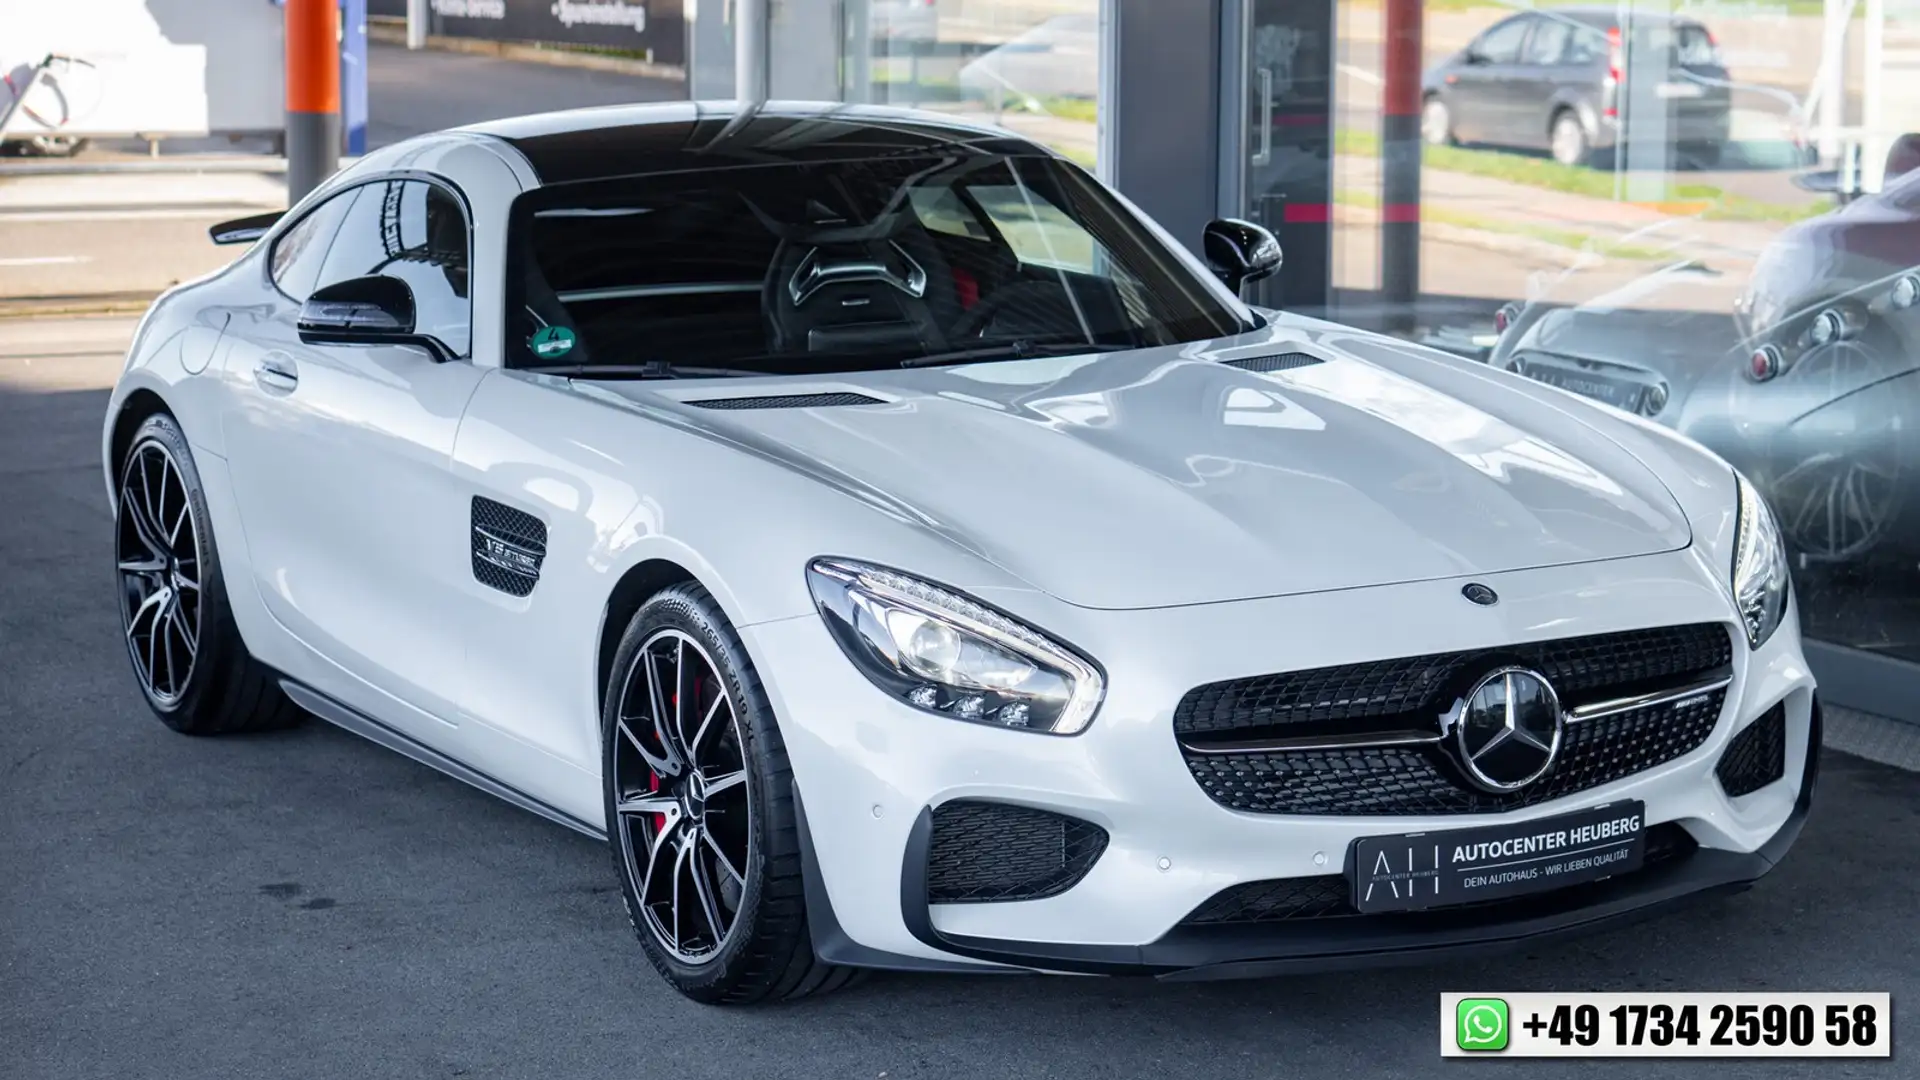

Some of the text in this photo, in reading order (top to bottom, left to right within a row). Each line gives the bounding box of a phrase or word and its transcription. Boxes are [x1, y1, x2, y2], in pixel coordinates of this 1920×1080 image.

[702, 622, 731, 667] 265/35
[728, 671, 741, 693] ZR
[738, 694, 748, 716] 19
[1452, 815, 1640, 863] AUTOCENTER HEUBERG
[1365, 845, 1439, 902] AH
[1464, 876, 1487, 888] DEIN
[1489, 869, 1539, 885] AUTOHAUS
[1545, 864, 1562, 876] WIR
[1563, 859, 1592, 873] LIEBEN
[1593, 849, 1630, 867] QUALITÄT
